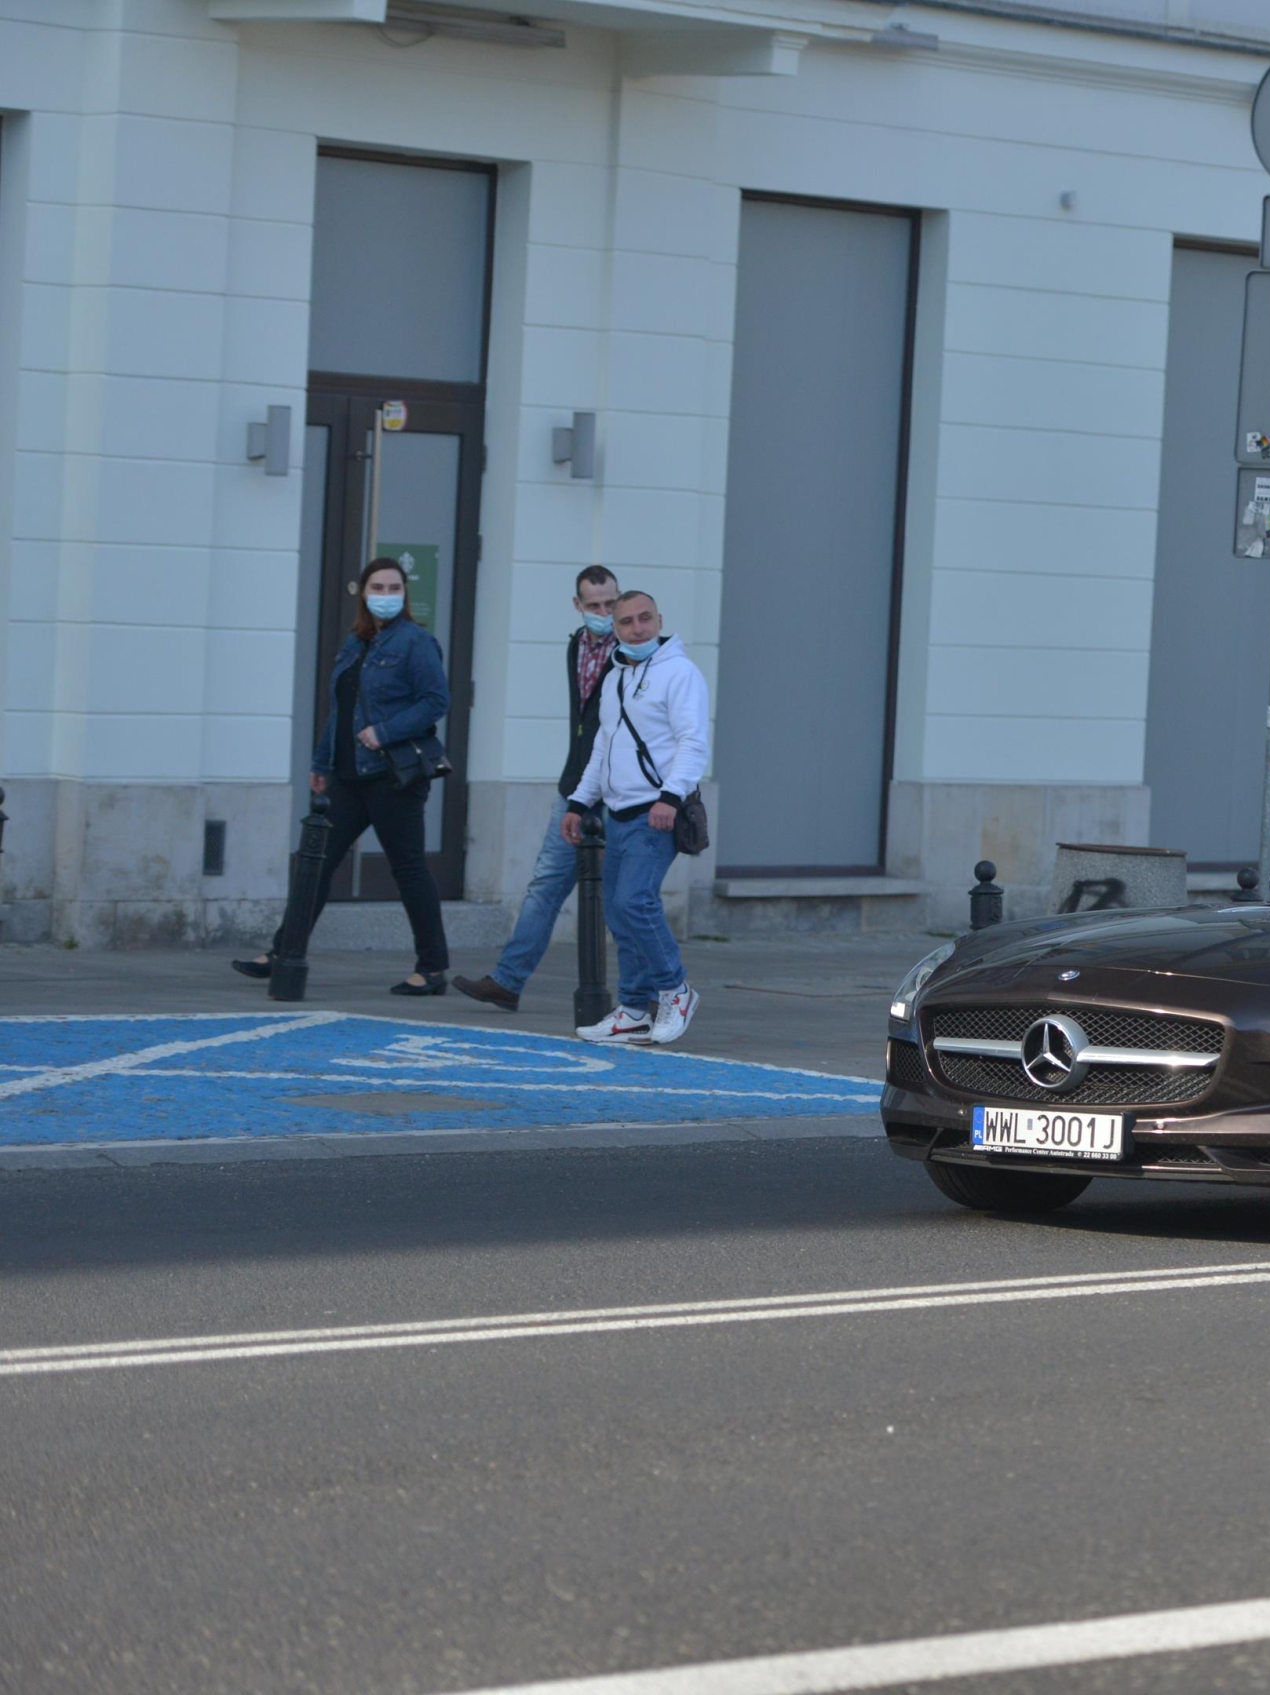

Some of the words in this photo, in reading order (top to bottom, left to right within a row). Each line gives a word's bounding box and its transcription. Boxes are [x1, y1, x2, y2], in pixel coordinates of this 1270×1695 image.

[974, 1130, 983, 1139] PL
[985, 1111, 1027, 1144] WWL
[1035, 1114, 1116, 1150] 3001J
[1004, 1146, 1032, 1154] Performance
[1032, 1148, 1049, 1156] Center
[1049, 1149, 1075, 1157] Autotrade
